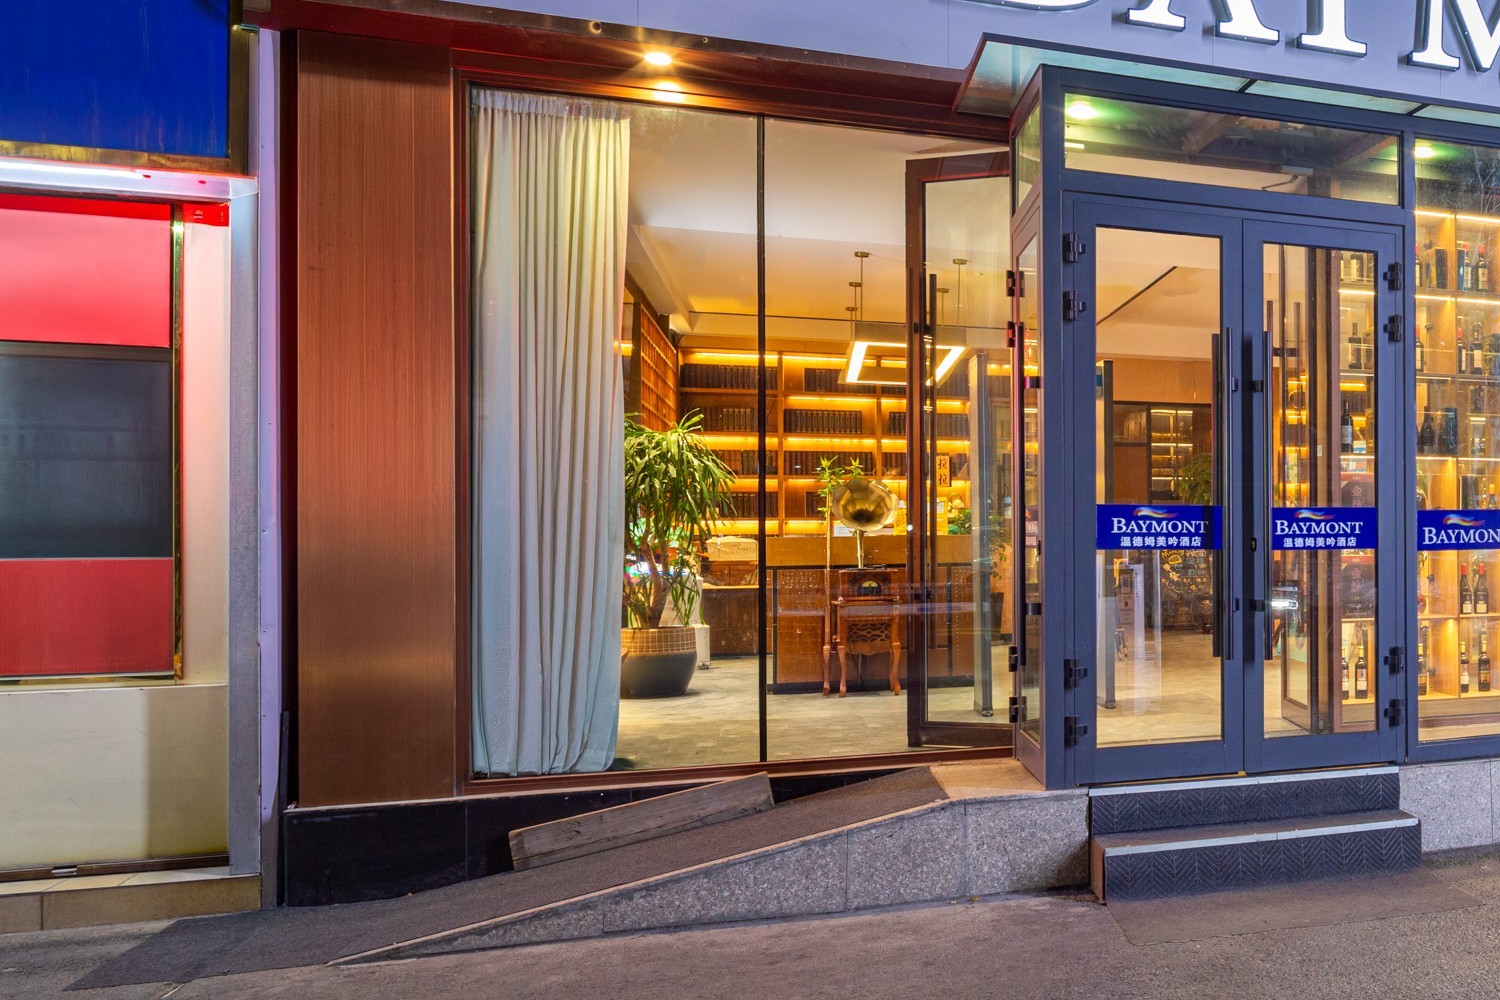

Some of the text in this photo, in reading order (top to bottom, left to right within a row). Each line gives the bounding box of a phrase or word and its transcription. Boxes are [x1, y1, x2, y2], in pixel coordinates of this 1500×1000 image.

[1111, 517, 1209, 533] BAYMONT
[1275, 520, 1363, 535] BAYMONT
[1120, 536, 1201, 547] 温德姆美吟酒店
[1283, 537, 1357, 548] 温德姆美吟酒店
